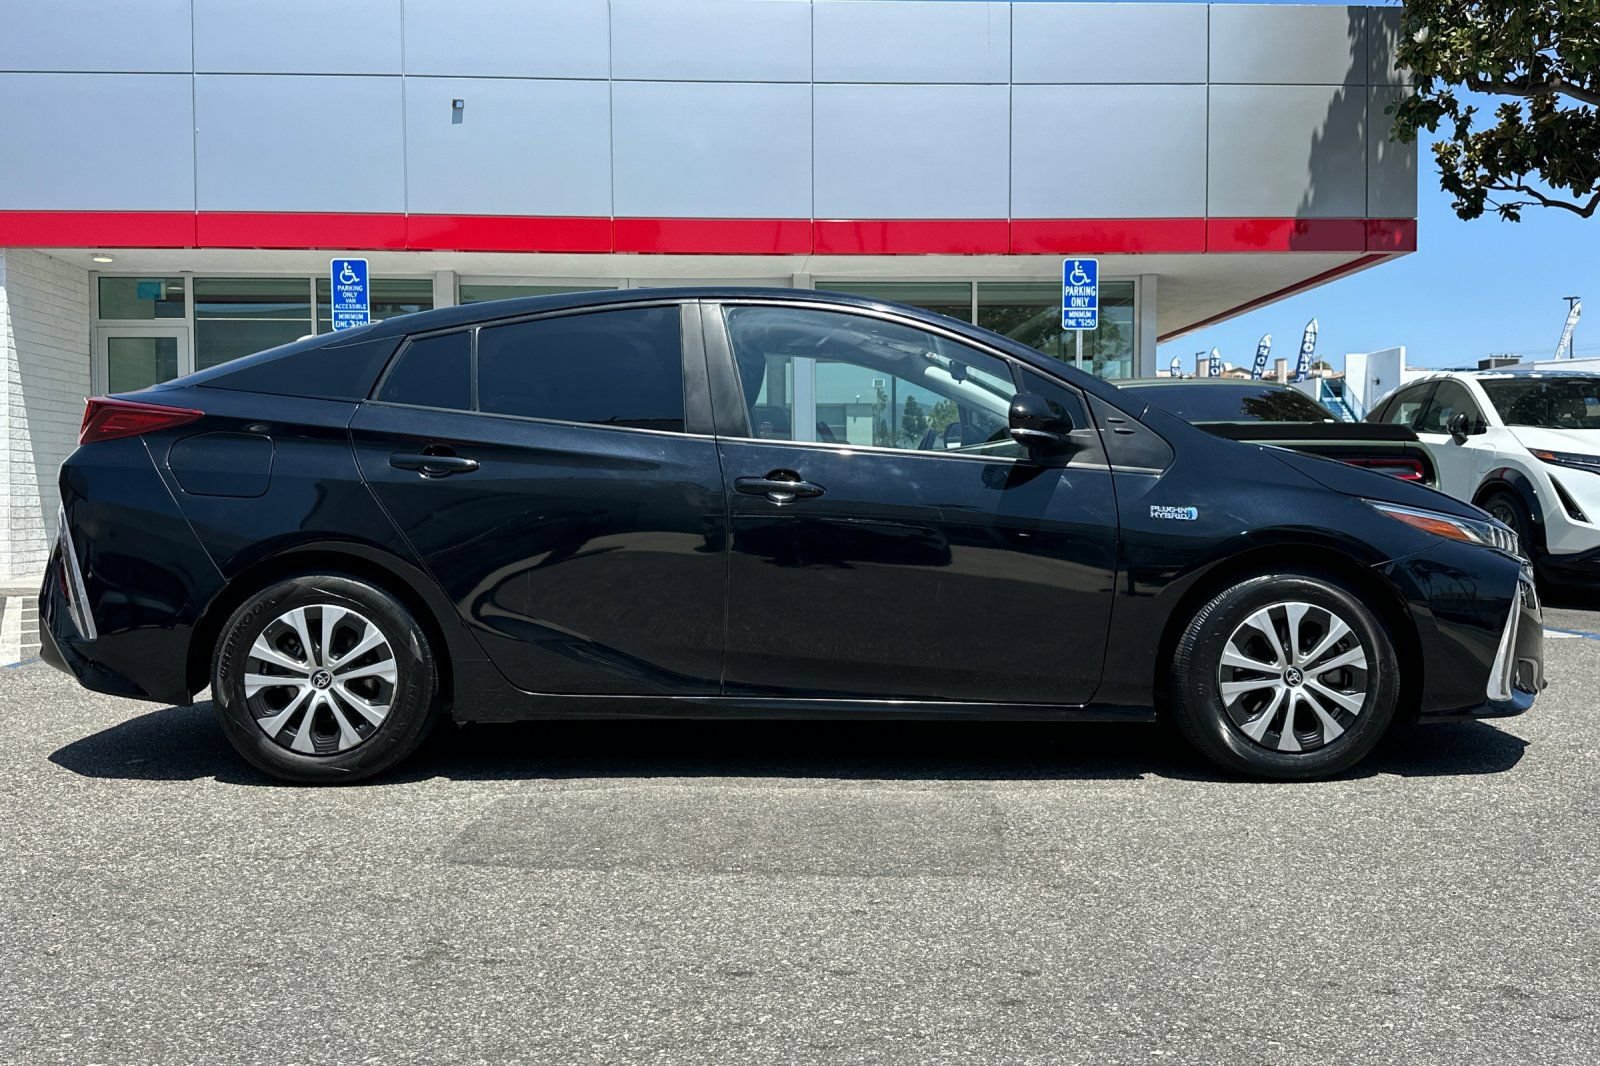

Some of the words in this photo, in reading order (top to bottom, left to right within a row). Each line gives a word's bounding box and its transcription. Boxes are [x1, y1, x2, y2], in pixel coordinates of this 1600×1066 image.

[1065, 286, 1096, 296] PARKING
[1071, 297, 1090, 307] ONLY
[1068, 310, 1092, 318] MINIMUM
[1065, 318, 1077, 326] FINE
[1150, 505, 1187, 513] PLUG-IN
[1150, 512, 1188, 520] HYBRID
